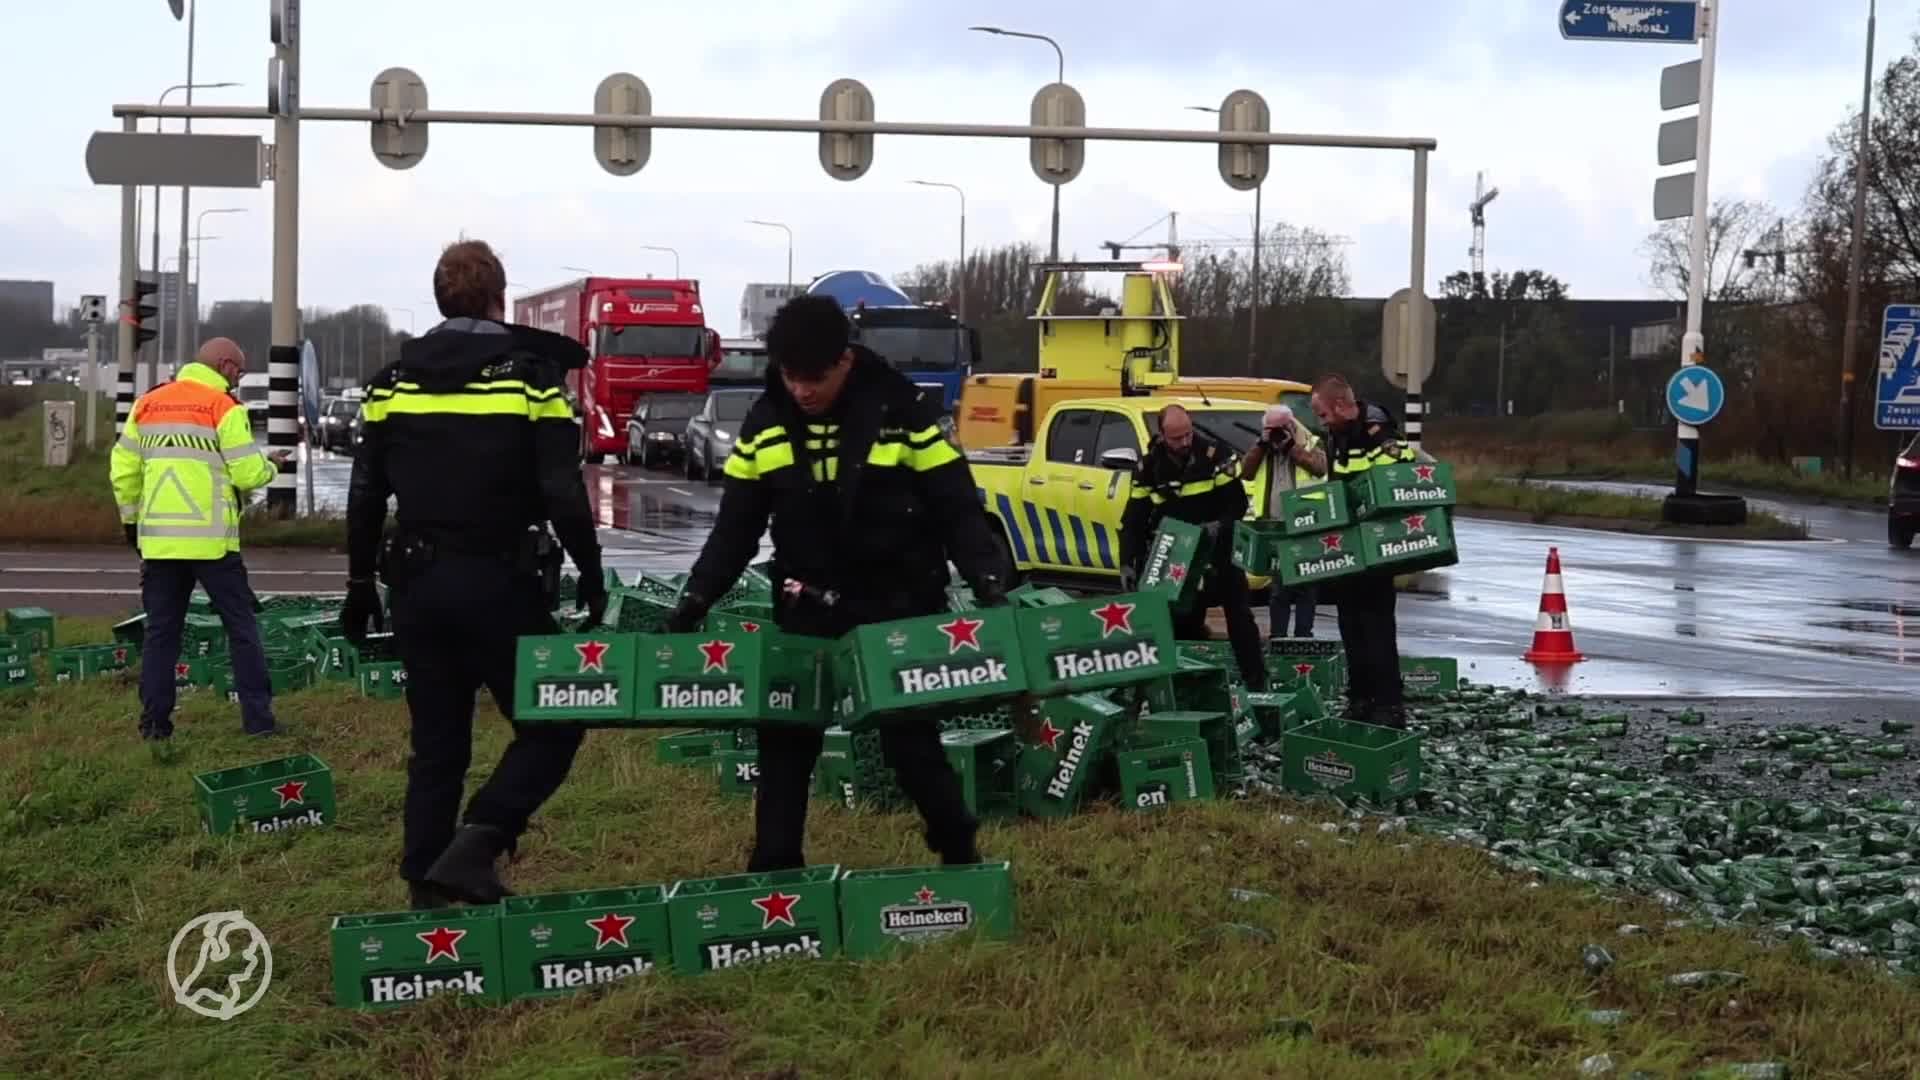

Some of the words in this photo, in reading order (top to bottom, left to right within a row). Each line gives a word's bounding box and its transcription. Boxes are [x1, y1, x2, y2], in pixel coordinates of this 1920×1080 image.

[1583, 3, 1670, 16] Zoetoude-
[1393, 487, 1447, 501] Heinek
[1294, 513, 1315, 527] en
[1381, 535, 1438, 557] Heinek
[1146, 534, 1175, 586] Heinek
[1298, 554, 1356, 576] Heinek
[1054, 643, 1159, 680] Heinek
[899, 659, 1008, 694] Heinek
[538, 683, 619, 708] Heinek
[661, 683, 745, 708] Heinek
[768, 687, 796, 710] en
[1047, 720, 1094, 798] Heinek
[1136, 785, 1166, 807] en
[888, 909, 964, 927] Heineken
